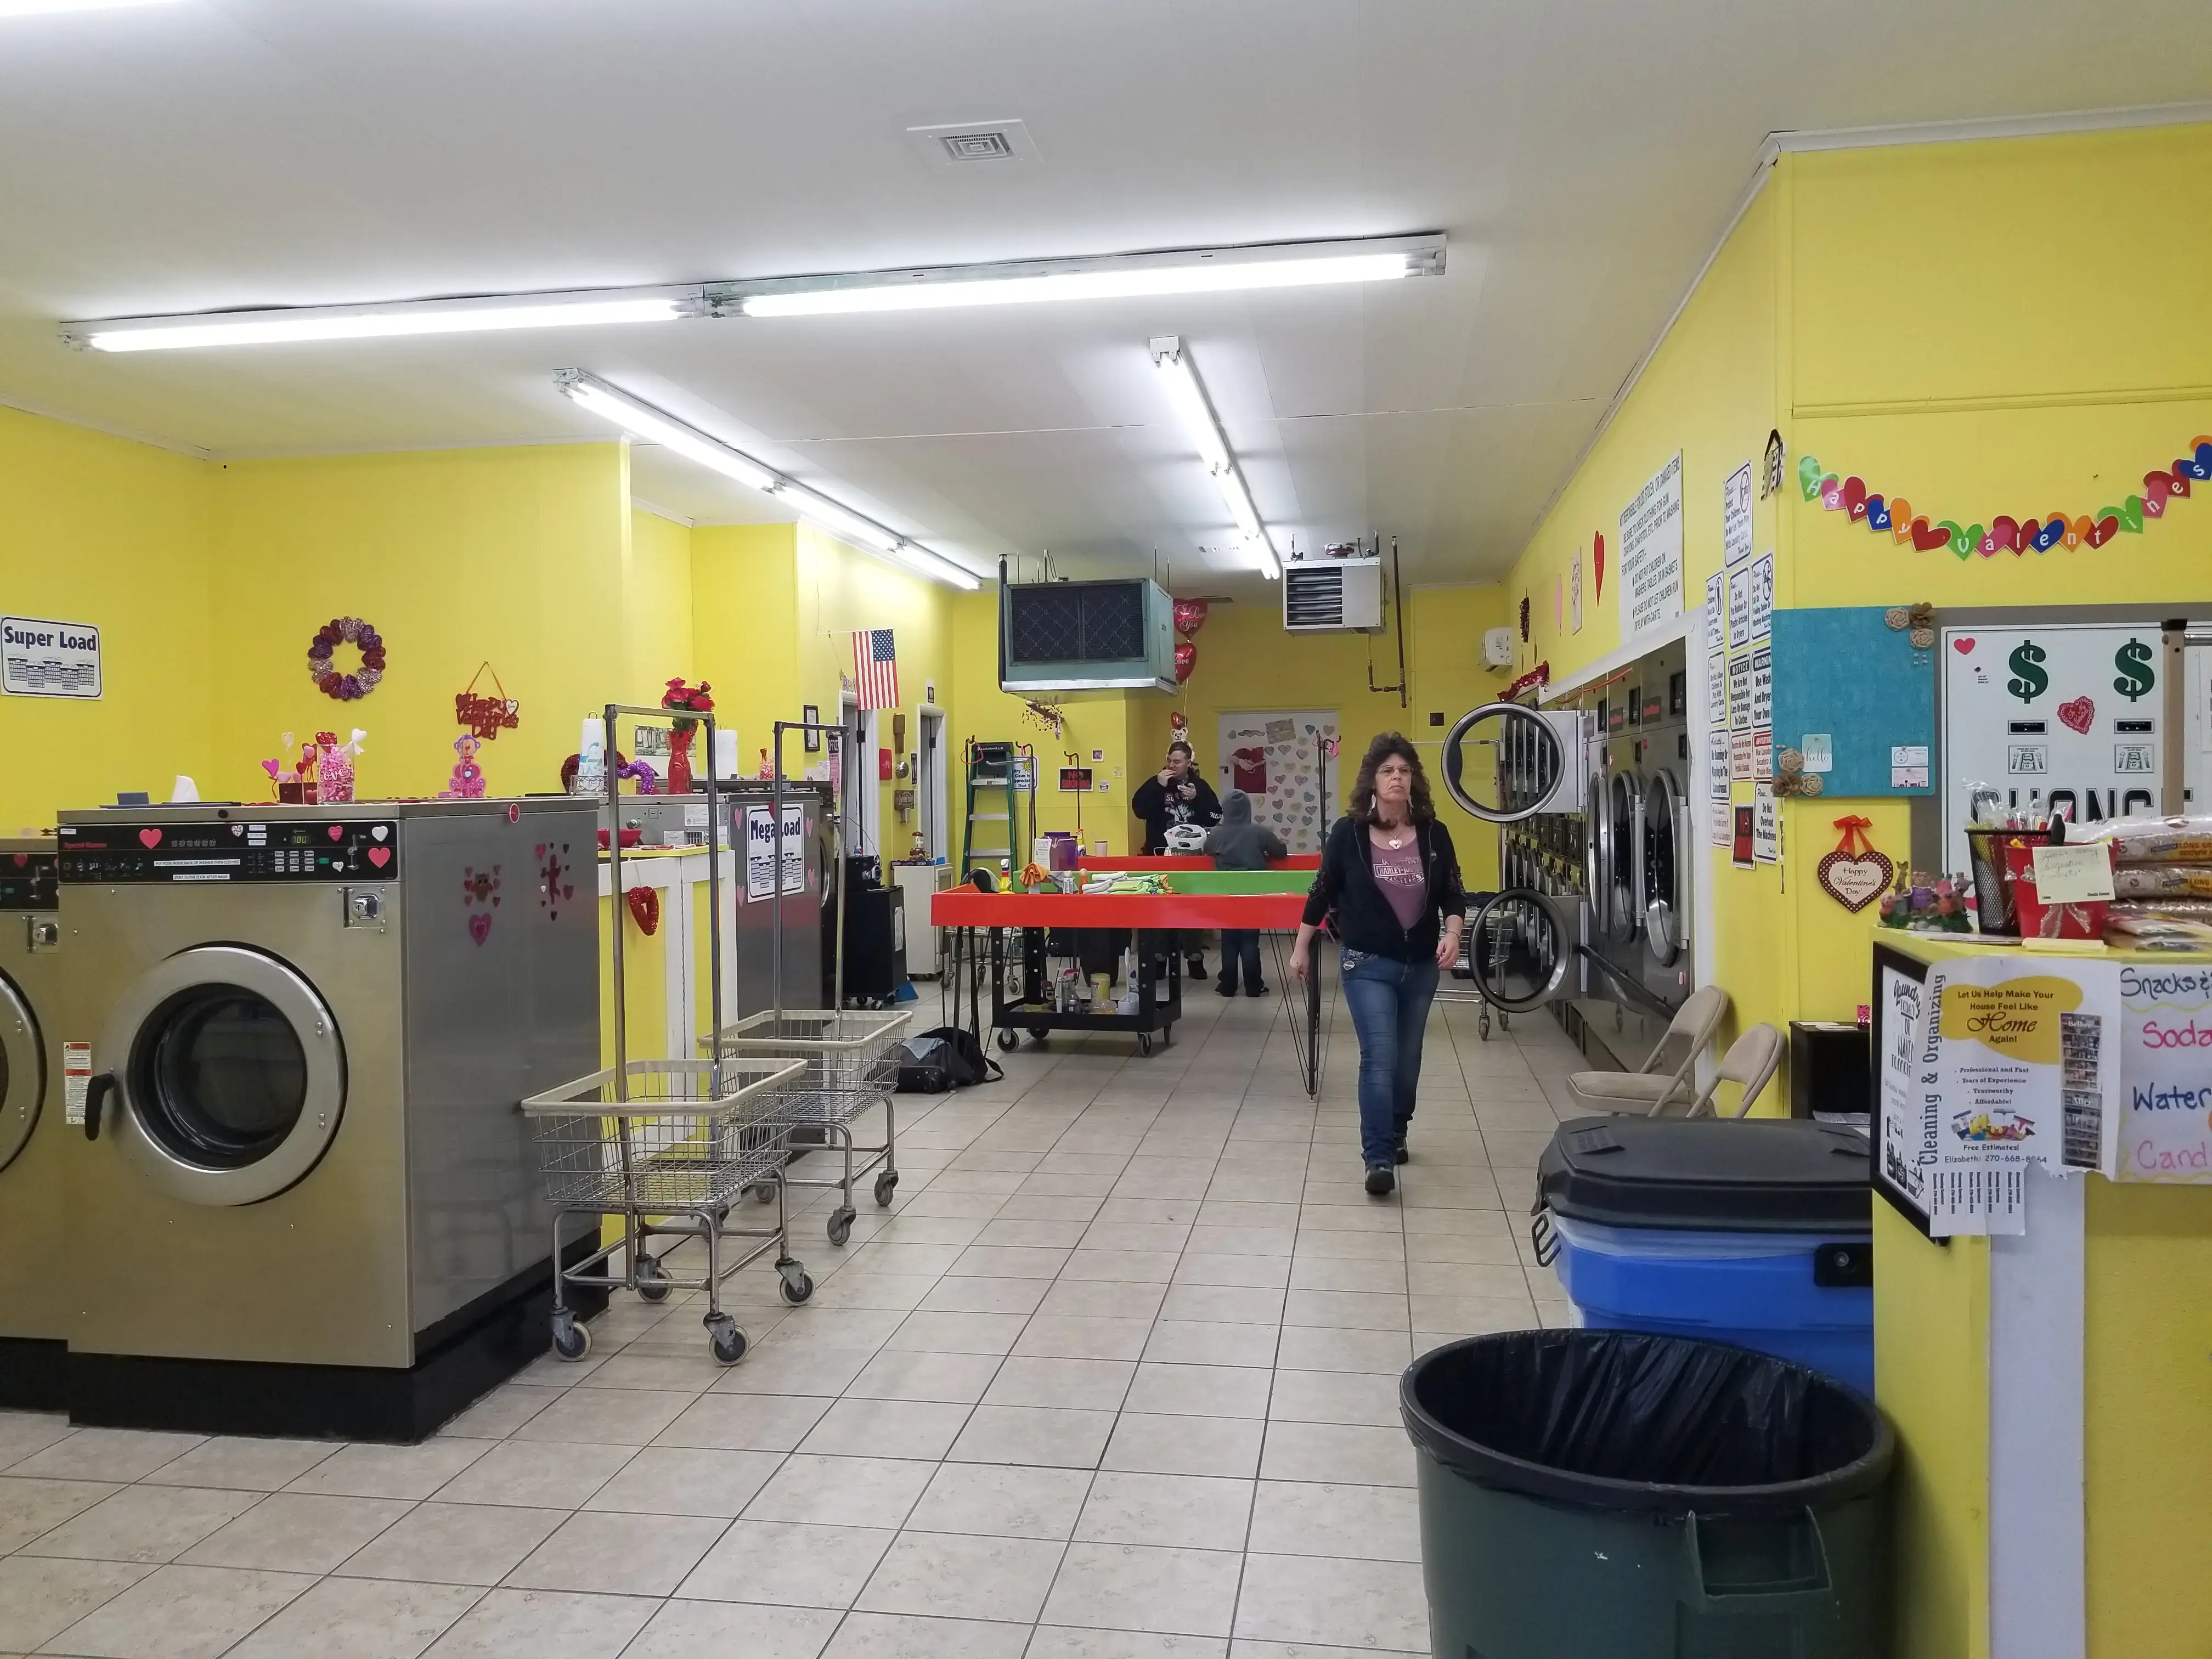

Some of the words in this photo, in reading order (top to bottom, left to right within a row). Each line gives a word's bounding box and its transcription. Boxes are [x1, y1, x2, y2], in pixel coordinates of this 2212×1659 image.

[1807, 479, 1910, 534] Happy
[1180, 620, 1198, 631] You
[4, 625, 54, 649] Super
[59, 631, 97, 651] Load
[1732, 661, 1748, 675] NOTICE
[1754, 656, 1771, 668] WARNIN
[2113, 637, 2155, 702] $
[2007, 640, 2049, 704] $
[1733, 679, 1737, 689] We
[1731, 688, 1745, 703] Responsible
[1806, 746, 1828, 762] hello
[1763, 803, 1766, 813] Do
[751, 820, 775, 843] Mega
[781, 817, 800, 837] oad
[1760, 816, 1773, 827] Overload
[1763, 830, 1776, 841] Machines
[1843, 867, 1867, 876] Happy
[1834, 876, 1876, 887] Valentine's
[2120, 967, 2196, 1000] Snacks
[1900, 999, 1915, 1017] TODAY
[1905, 1018, 1910, 1037] OR
[1922, 974, 1946, 1063] Organizing
[1967, 1012, 2038, 1032] Home
[1989, 1035, 2017, 1043] Again!
[2142, 1019, 2212, 1049] Soda
[1921, 1072, 1938, 1085] &
[2133, 1081, 2212, 1111] Water
[1919, 1094, 1942, 1165] Cleaning
[2137, 1140, 2212, 1170] Cand
